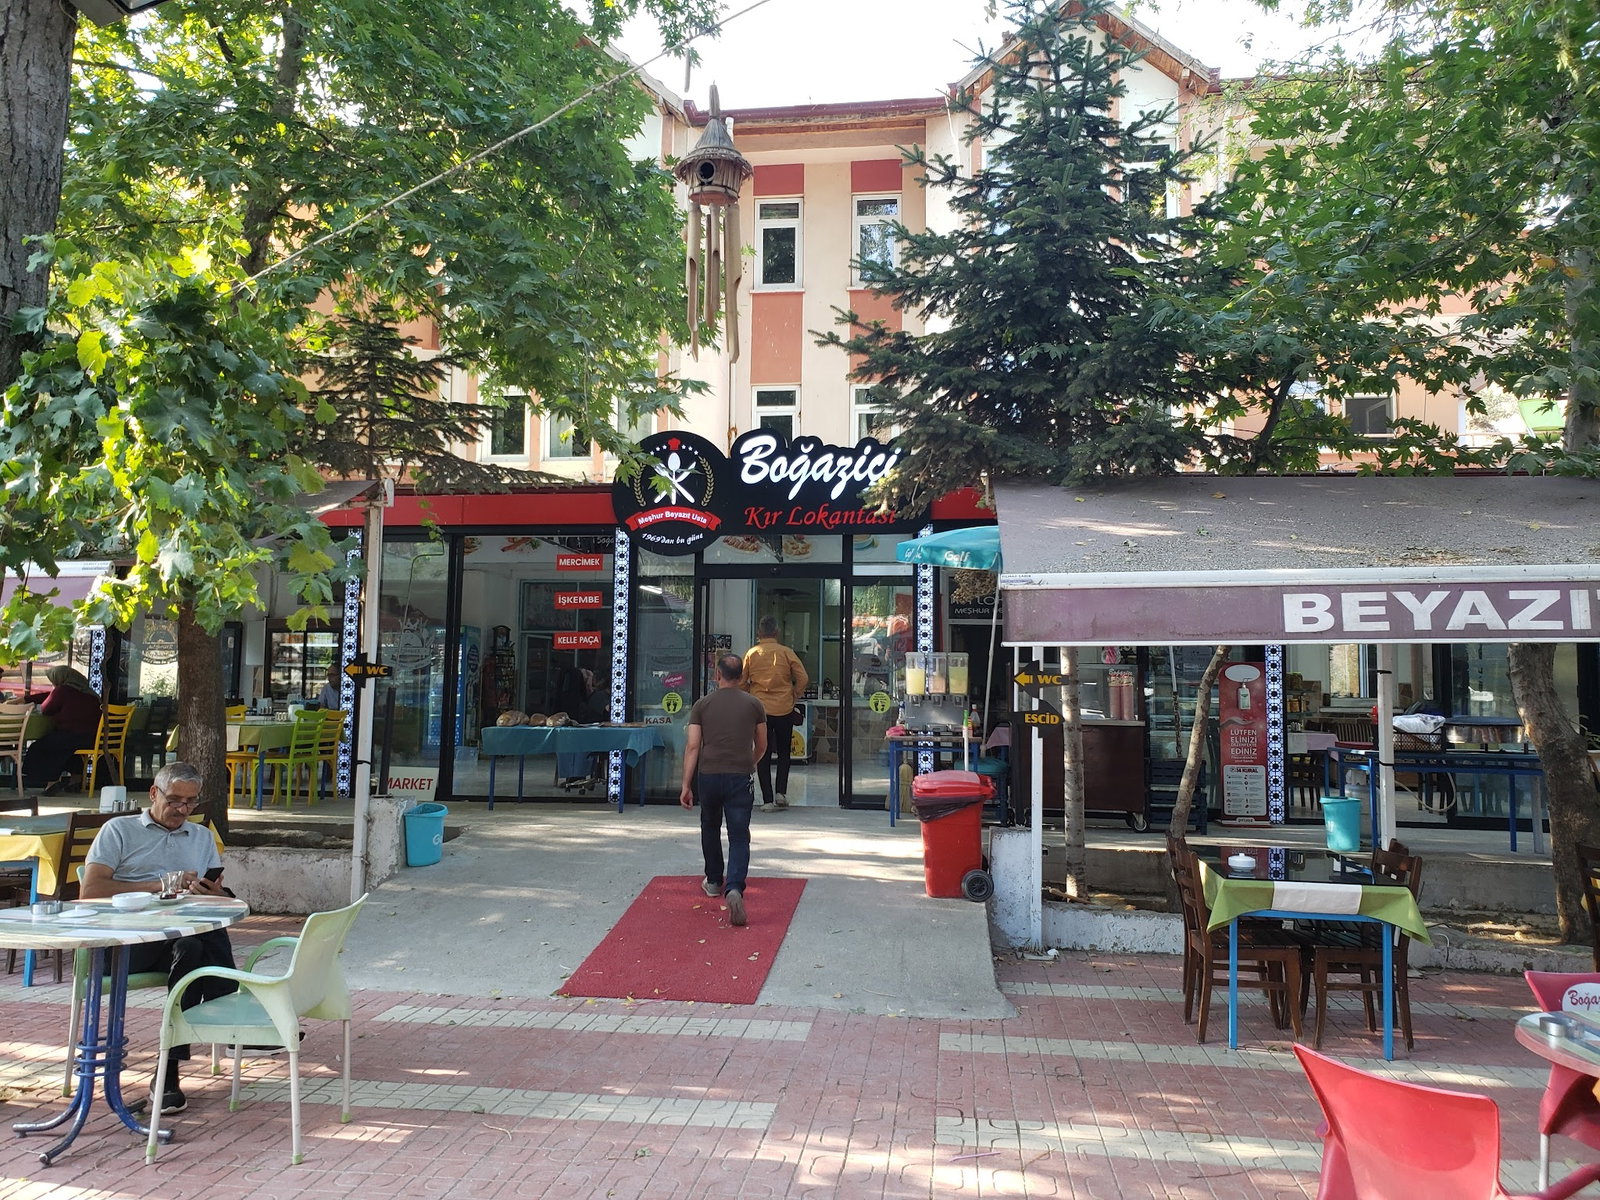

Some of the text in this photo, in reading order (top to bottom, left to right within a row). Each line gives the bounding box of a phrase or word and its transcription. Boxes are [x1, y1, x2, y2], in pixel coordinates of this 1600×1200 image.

[740, 435, 901, 501] Boğaziçi
[638, 512, 664, 525] Meşhur
[692, 513, 707, 524] Usta
[744, 507, 782, 529] Kır
[559, 557, 600, 566] MERCİMEK
[944, 550, 971, 562] Golf
[558, 595, 600, 605] İŞKEMBE
[1282, 589, 1600, 633] BEYAZI
[557, 635, 600, 645] KELLE PAÇA
[366, 665, 389, 675] WC
[1036, 675, 1062, 685] WC
[1024, 712, 1060, 725] ESCİD
[1230, 747, 1257, 755] EDİNİZ
[1567, 989, 1600, 1011] Boğa
